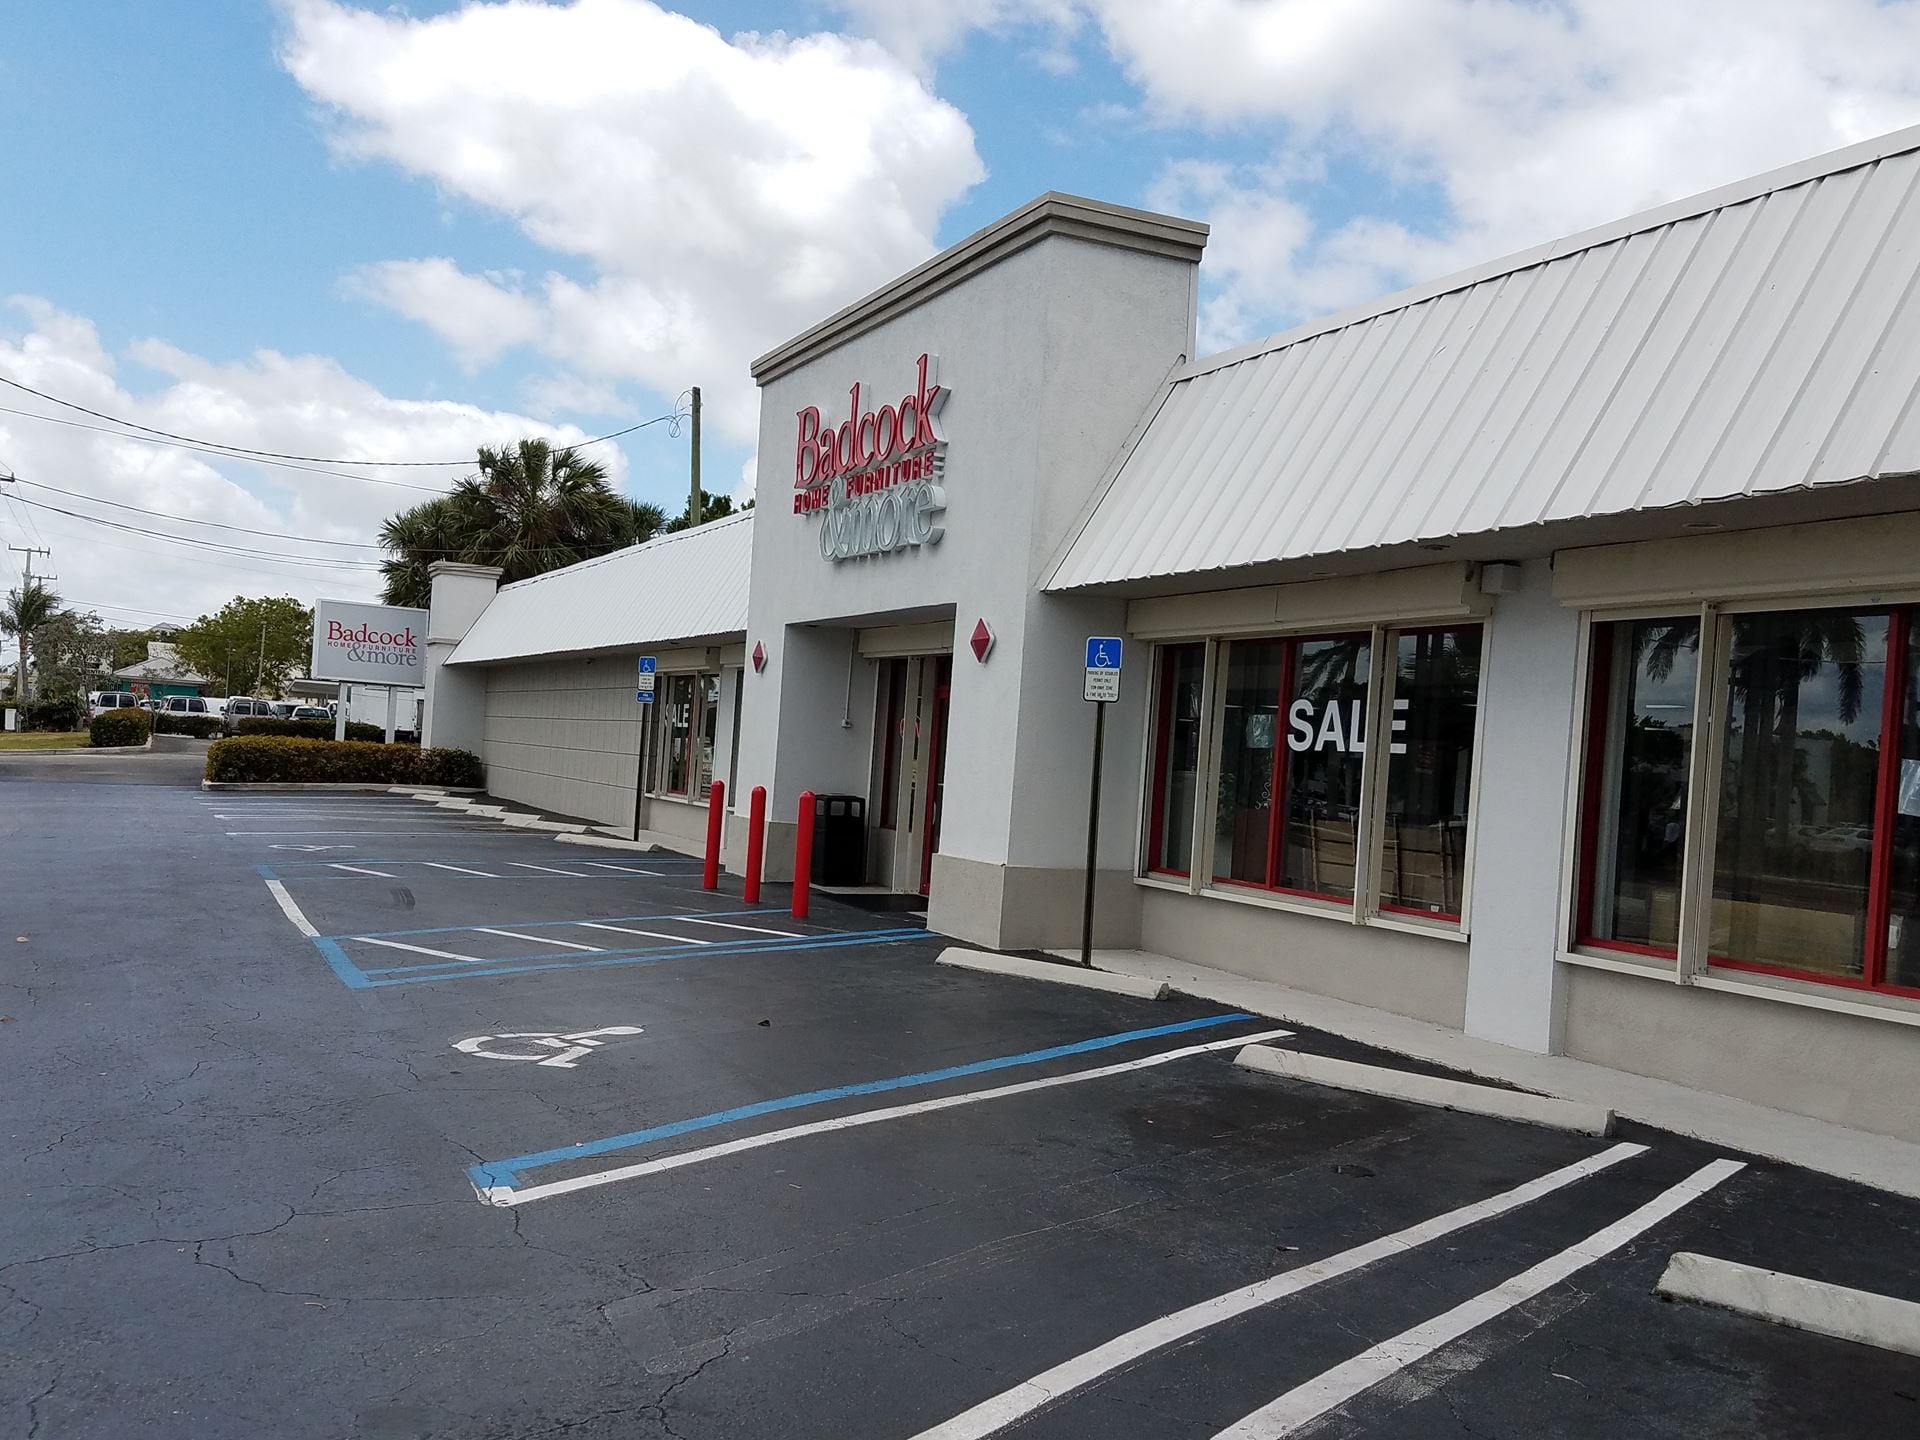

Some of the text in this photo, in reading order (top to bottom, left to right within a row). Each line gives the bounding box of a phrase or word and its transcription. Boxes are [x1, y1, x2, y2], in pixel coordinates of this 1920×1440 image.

[795, 353, 943, 489] Badcock
[793, 451, 935, 515] HOME FURNITURE
[819, 475, 945, 562] &more
[327, 620, 417, 648] Badcock
[327, 641, 416, 654] HOME FURNITURE
[347, 641, 417, 667] &more
[1287, 699, 1409, 754] SALE
